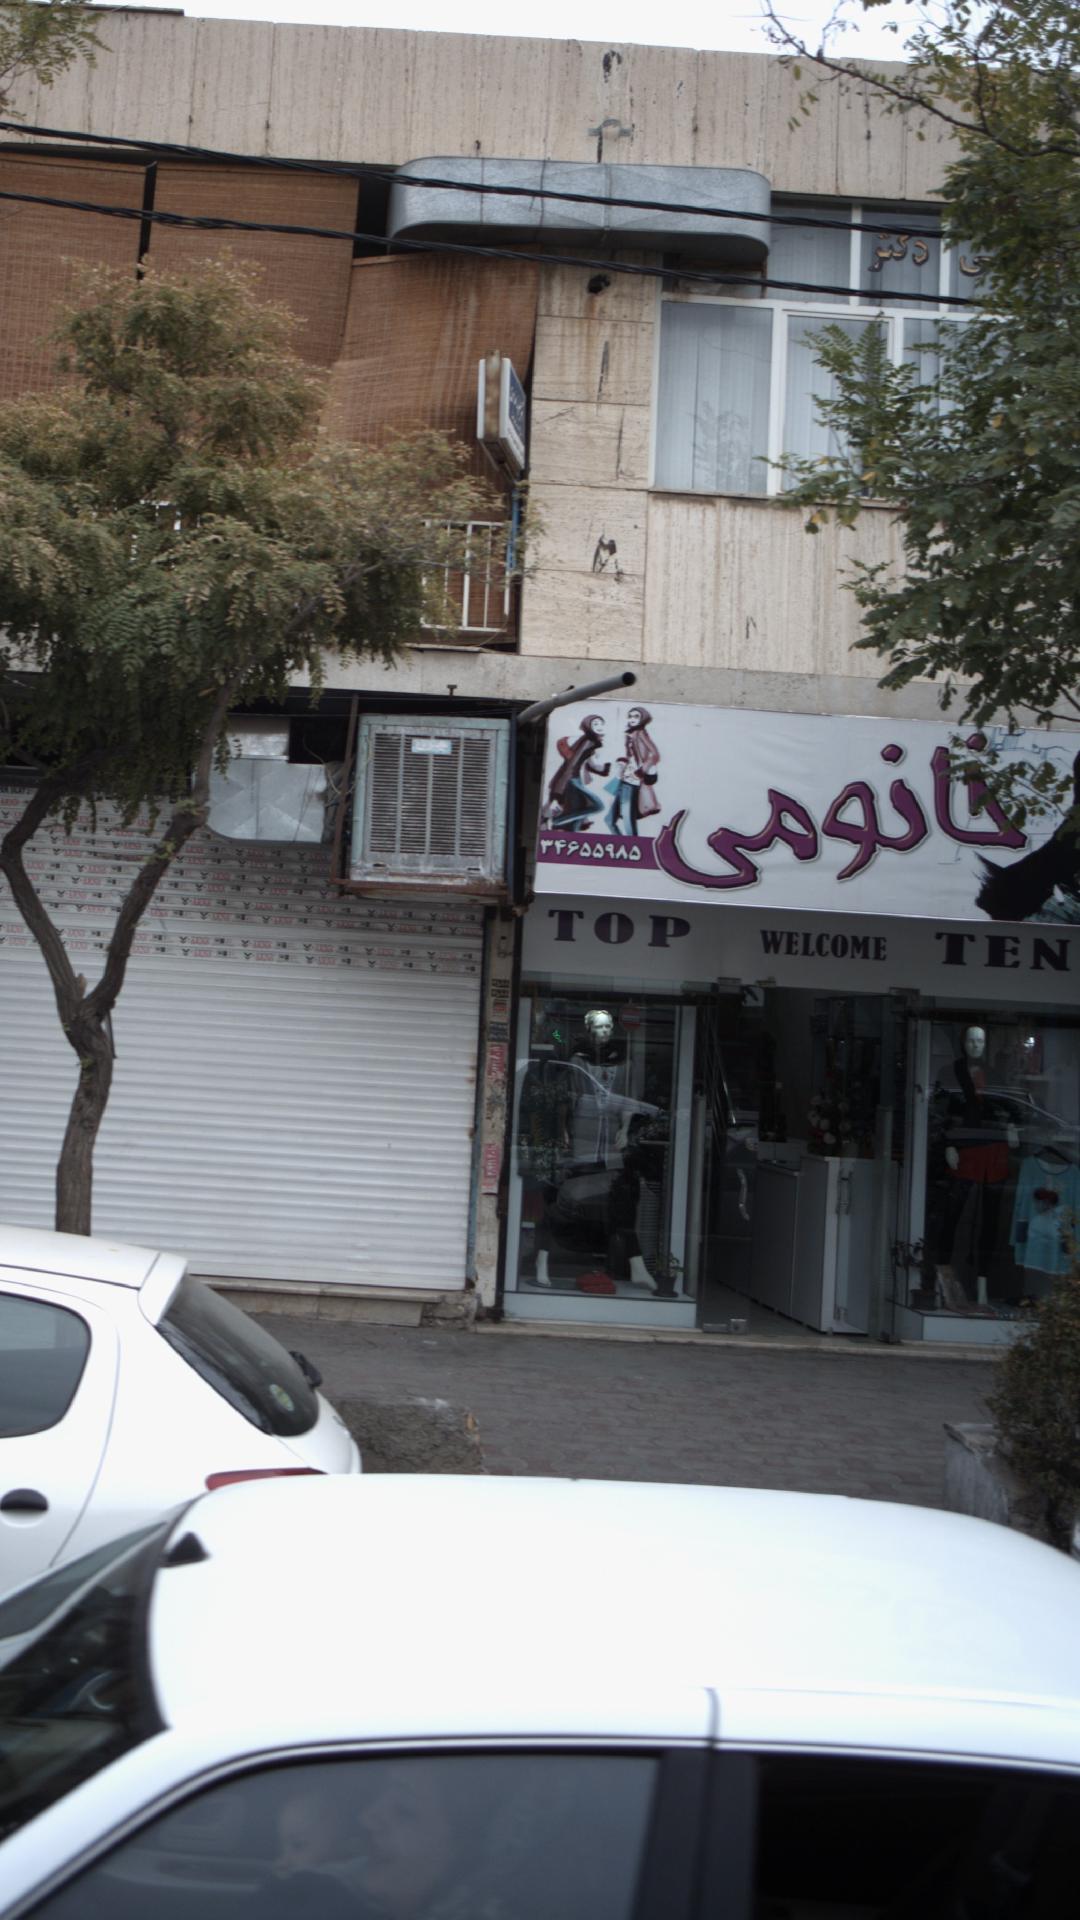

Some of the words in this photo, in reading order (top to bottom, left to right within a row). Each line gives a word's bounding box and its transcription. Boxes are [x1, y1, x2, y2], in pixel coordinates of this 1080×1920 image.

[548, 909, 692, 948] TOP
[761, 930, 887, 961] WELCOME
[935, 932, 1072, 971] TEN
